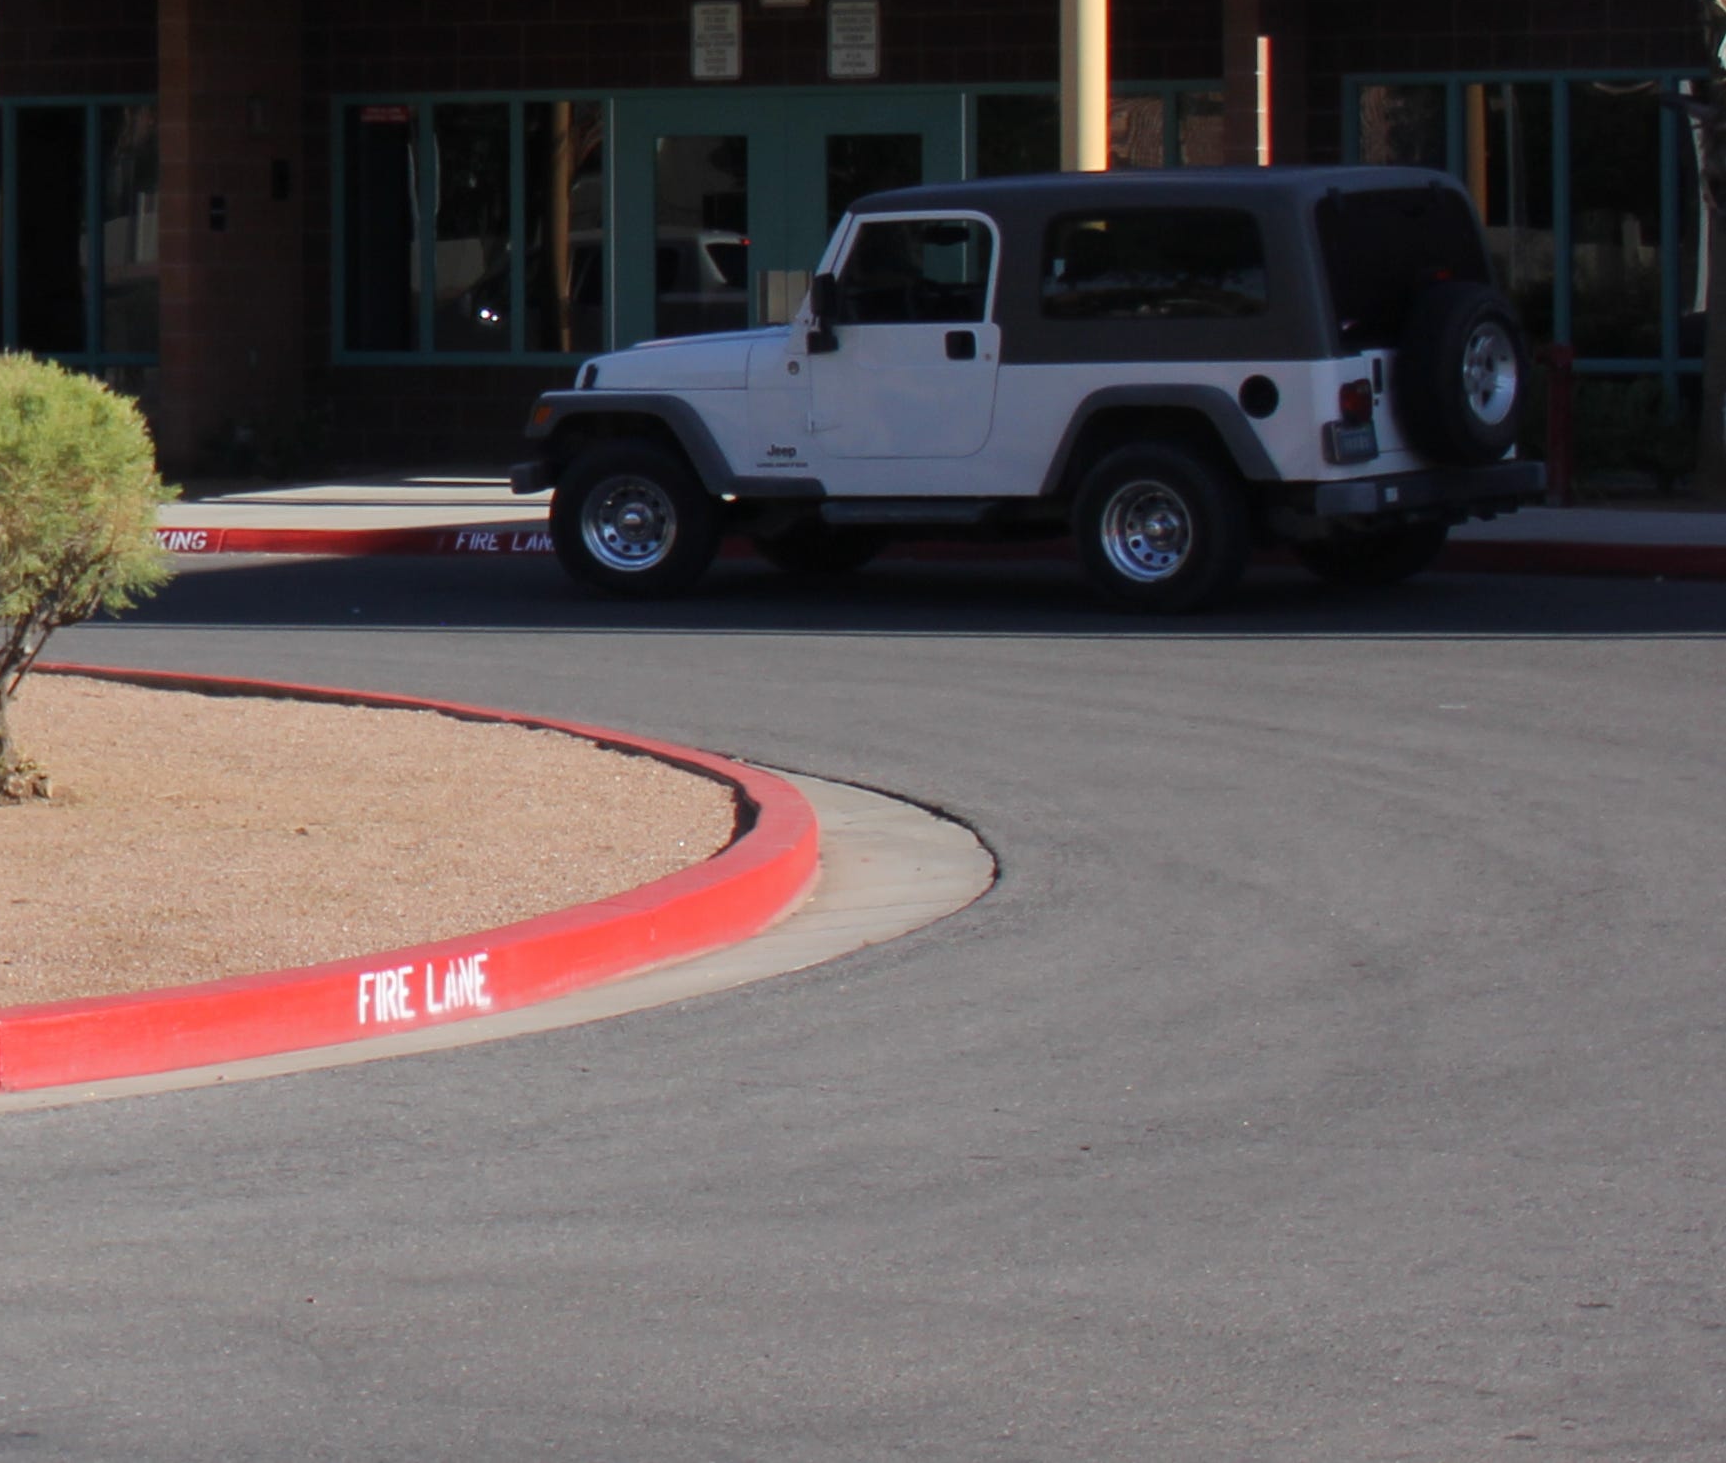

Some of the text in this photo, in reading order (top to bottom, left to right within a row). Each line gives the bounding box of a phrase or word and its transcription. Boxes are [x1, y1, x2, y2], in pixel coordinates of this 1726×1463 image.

[766, 443, 798, 458] Jeep
[154, 530, 209, 551] KING
[454, 531, 556, 551] FIRE LAN
[358, 952, 492, 1025] FIRE LANE
